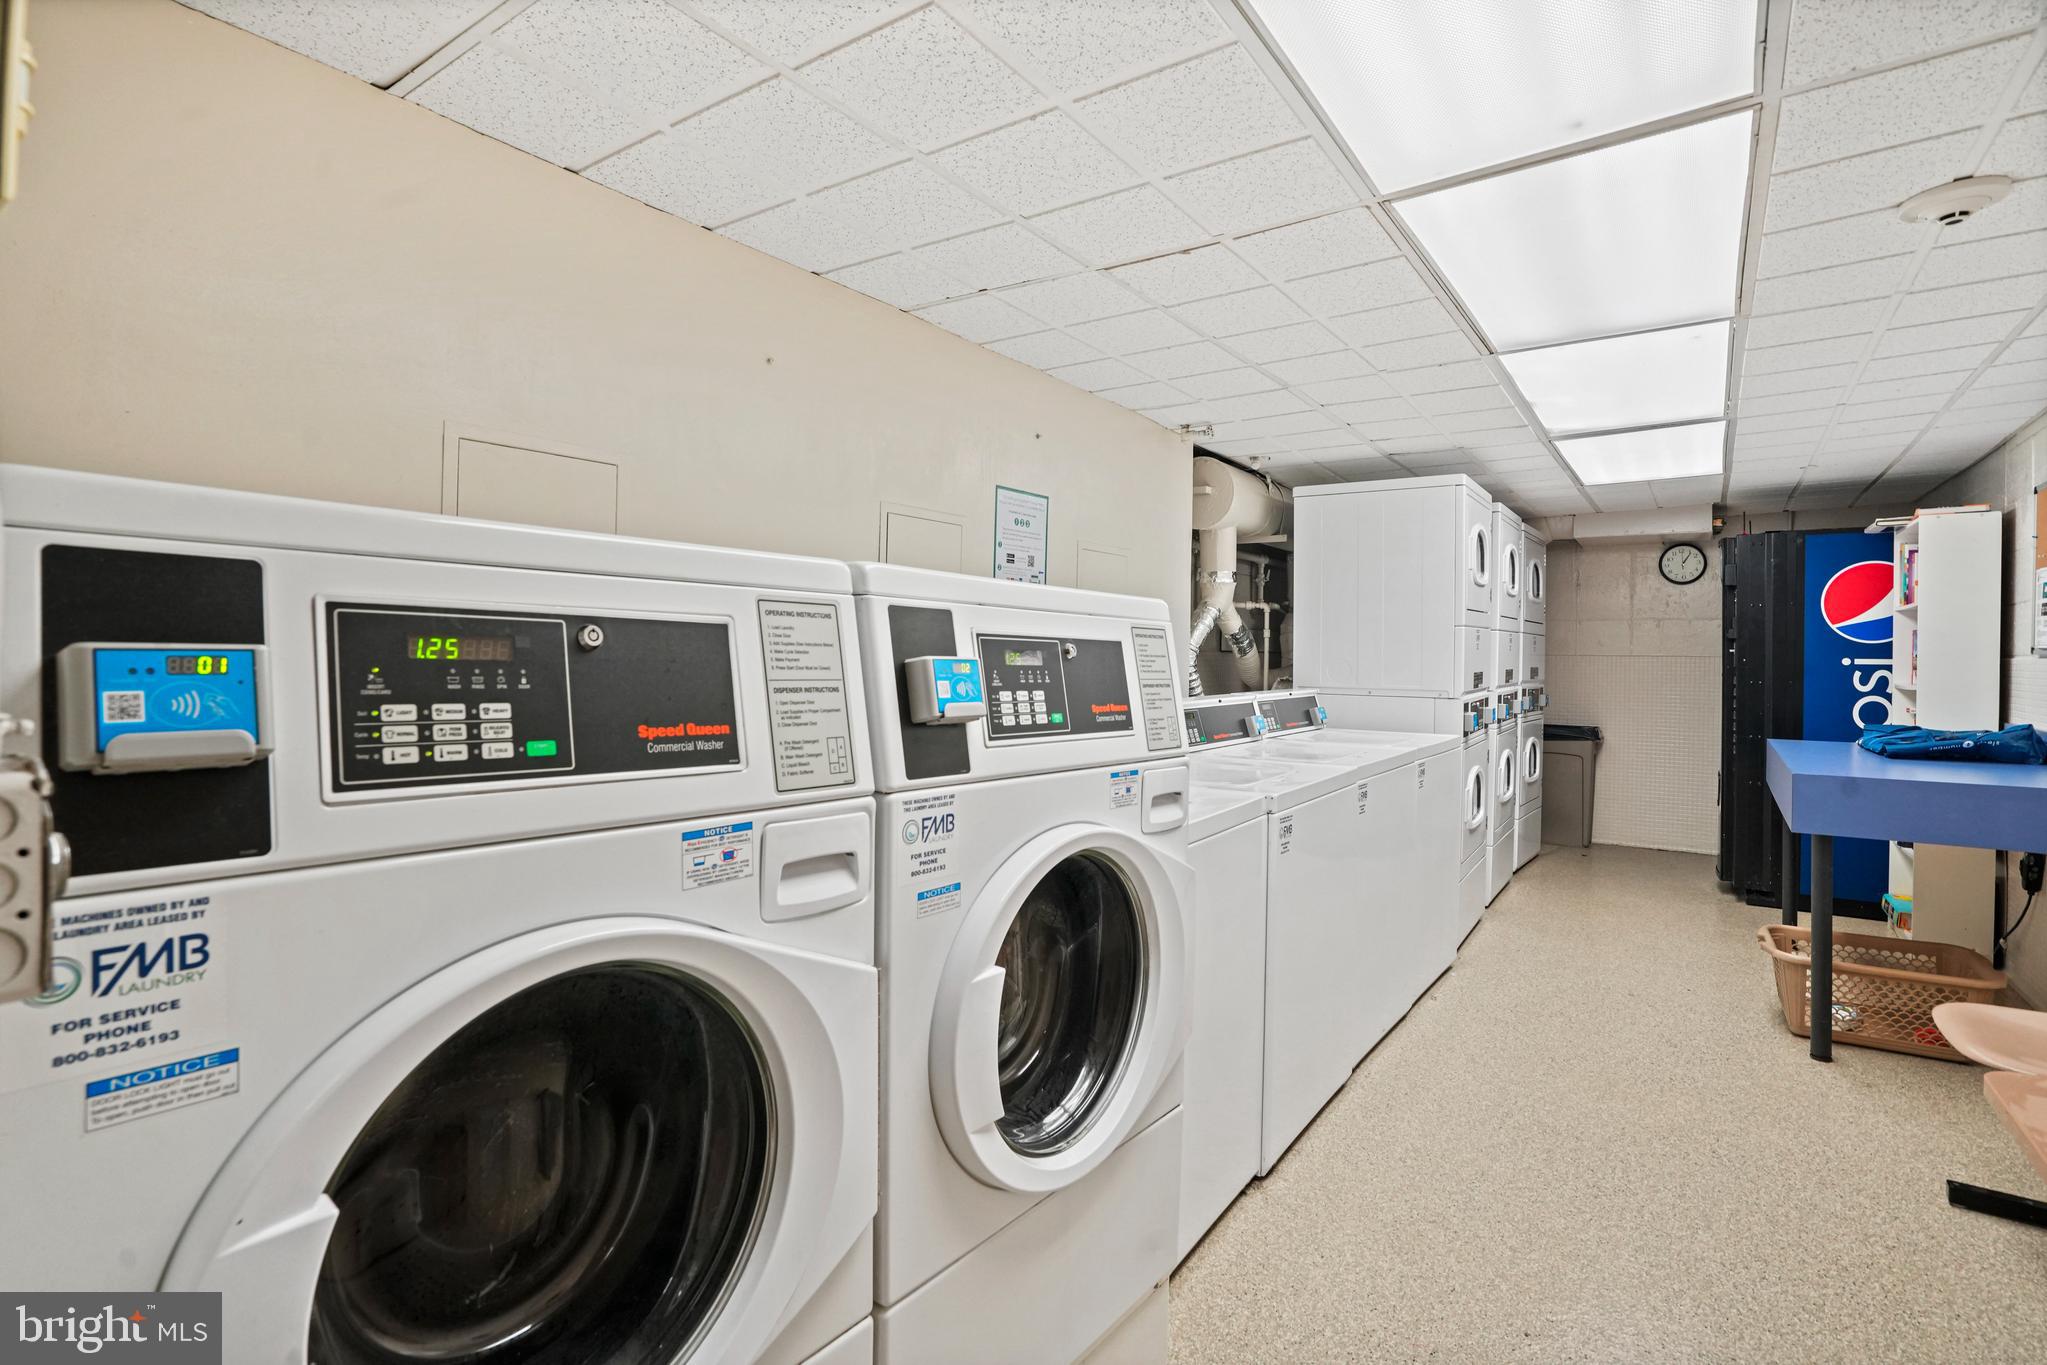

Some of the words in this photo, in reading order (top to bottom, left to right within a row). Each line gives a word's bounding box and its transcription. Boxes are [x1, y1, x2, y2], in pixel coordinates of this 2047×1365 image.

[197, 656, 228, 675] 01
[638, 724, 685, 739] Speed
[686, 722, 730, 736] Queen
[647, 741, 695, 753] Commercial
[696, 740, 724, 750] Washer
[704, 826, 733, 837] NOTICE
[922, 813, 955, 843] FMB
[911, 853, 922, 861] FOR
[924, 848, 947, 858] SERVICE
[919, 858, 938, 867] PHONE
[924, 885, 954, 898] NOTICE
[61, 909, 123, 926] MACHINES
[127, 903, 167, 917] OWNED
[170, 900, 185, 911] BY
[188, 897, 210, 907] AND
[54, 925, 110, 941] LAUNDRY
[113, 919, 143, 932] AREA
[147, 913, 188, 927] LEASED
[191, 910, 206, 921] BY
[92, 933, 210, 998] FMB
[118, 969, 207, 997] LAUNDRY
[51, 1018, 92, 1036] FOR
[99, 999, 181, 1026] SERVICE
[83, 1021, 152, 1045] PHONE
[52, 1030, 181, 1068] 800-832-6193
[109, 1054, 221, 1091] NOTICE
